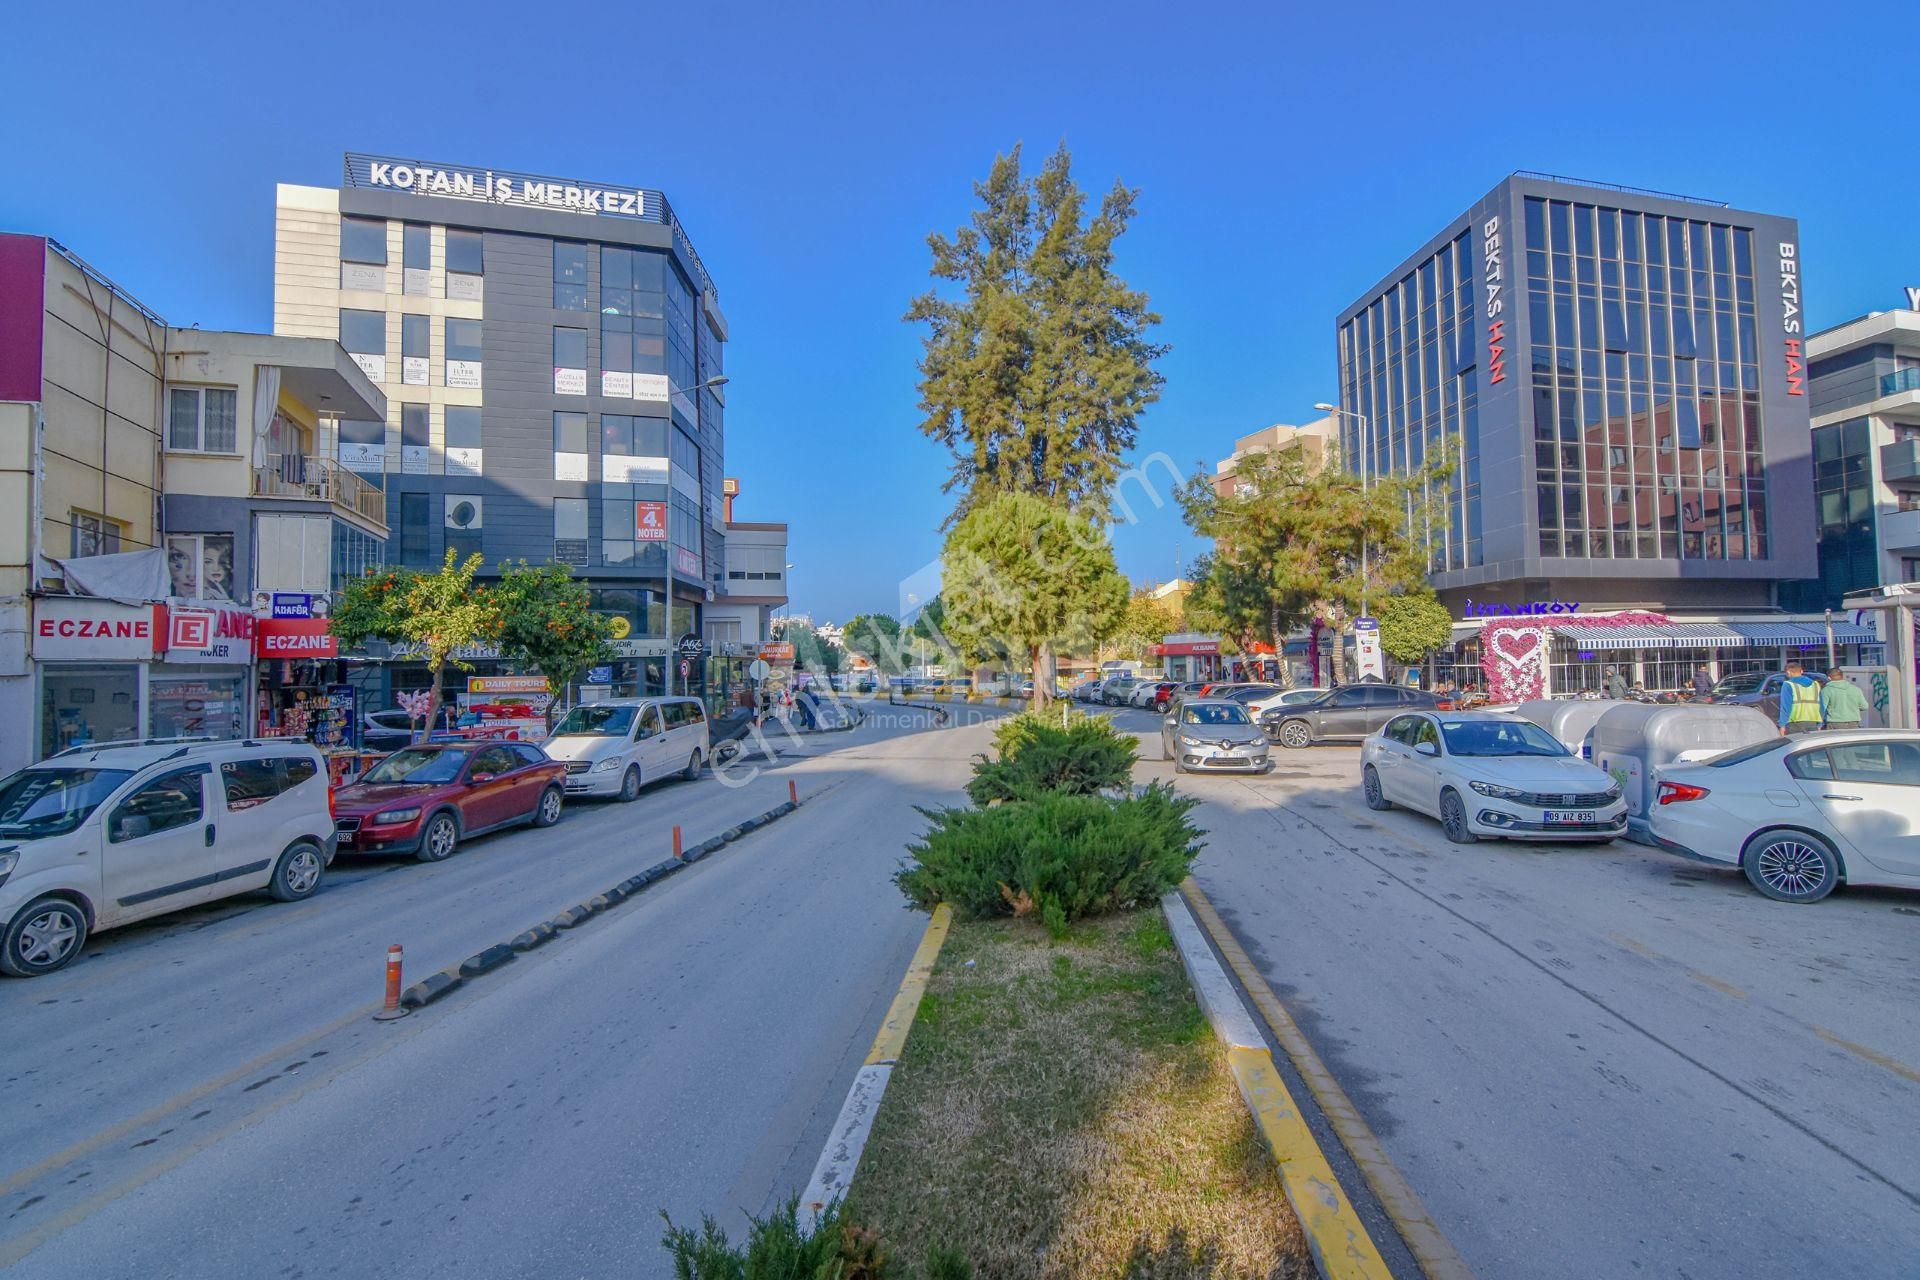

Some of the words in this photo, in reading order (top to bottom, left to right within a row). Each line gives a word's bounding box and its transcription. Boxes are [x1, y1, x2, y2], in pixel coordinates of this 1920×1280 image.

[370, 162, 474, 197] KOTAN
[486, 170, 513, 203] İŞ
[523, 180, 645, 216] MERKEZİ
[1488, 320, 1506, 385] HAN
[1784, 338, 1805, 397] HAN
[638, 528, 665, 538] NOTER
[1465, 597, 1580, 618] İSTANKÖY
[39, 619, 149, 638] ECZANE
[266, 635, 331, 650] ECZANE
[485, 680, 512, 688] DAILY
[1550, 812, 1560, 821] 09
[1562, 812, 1575, 821] AIZ
[1577, 811, 1592, 821] 835
